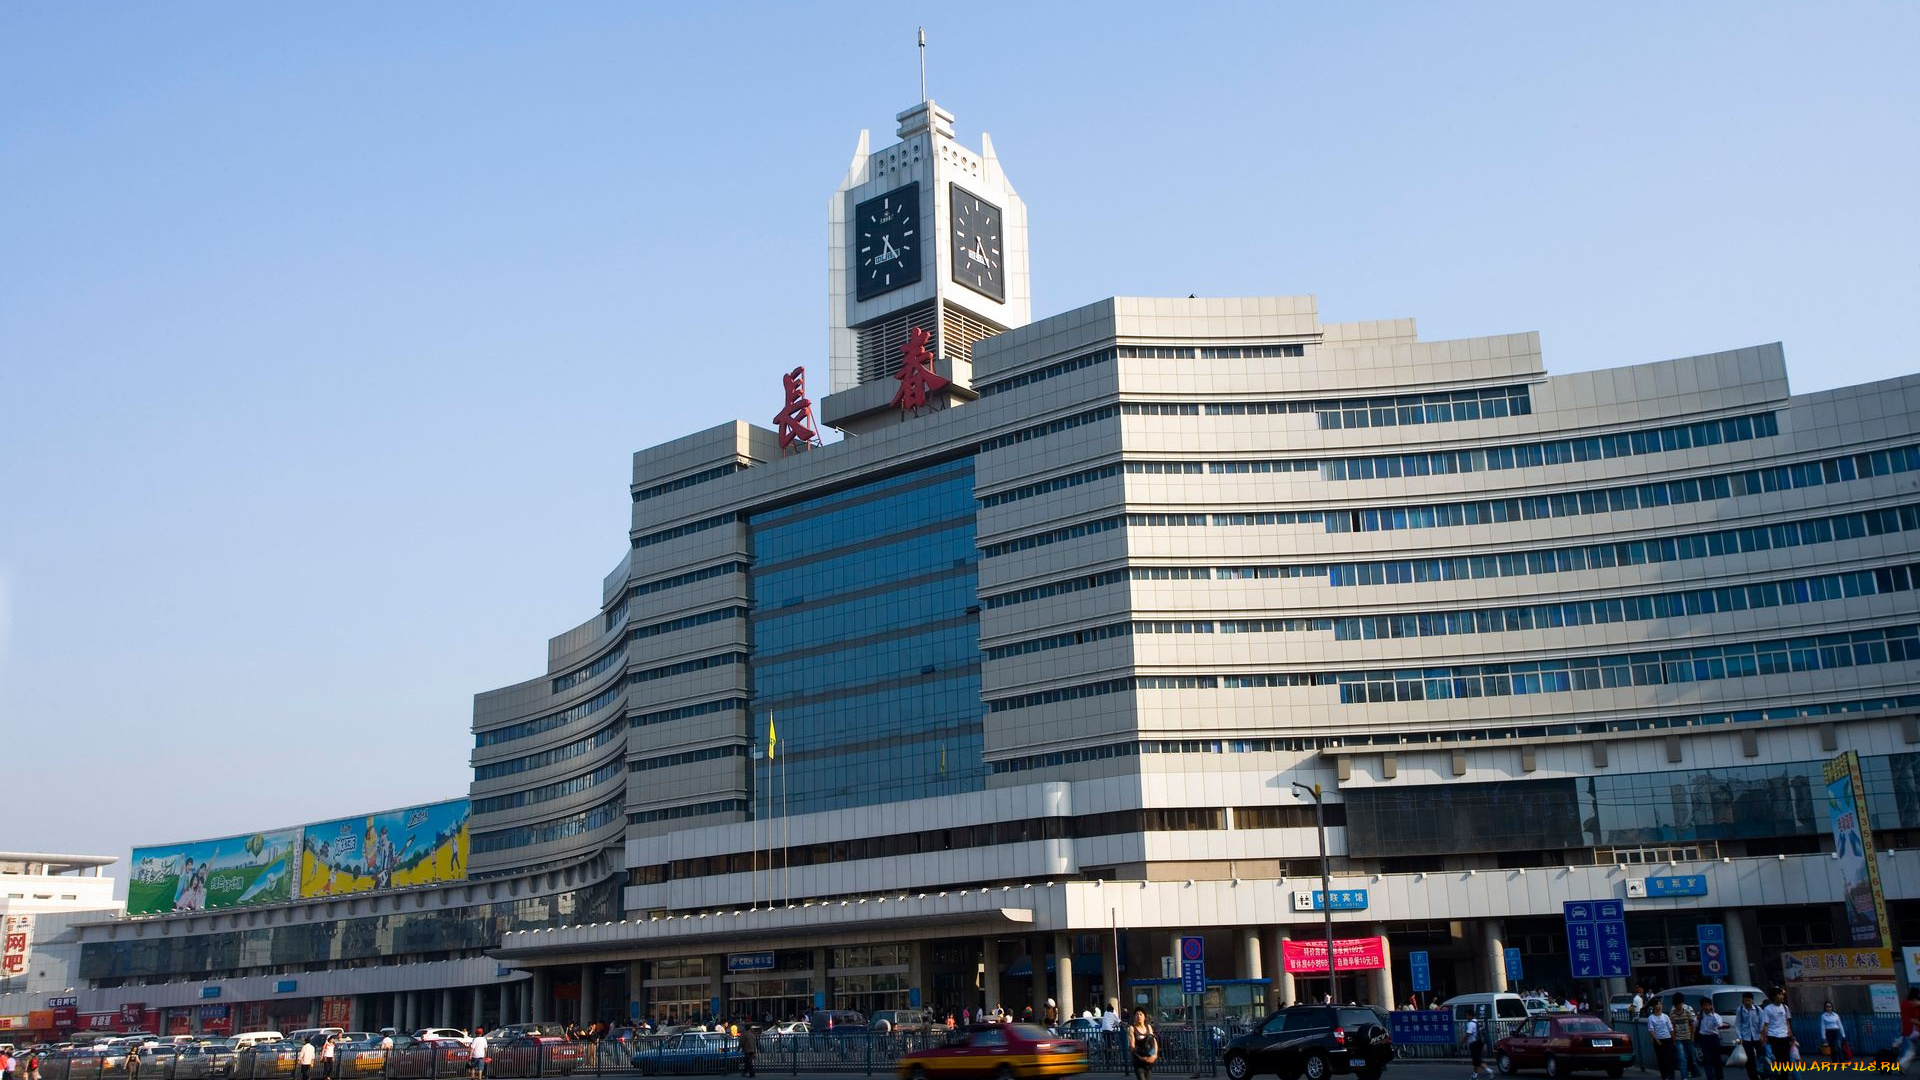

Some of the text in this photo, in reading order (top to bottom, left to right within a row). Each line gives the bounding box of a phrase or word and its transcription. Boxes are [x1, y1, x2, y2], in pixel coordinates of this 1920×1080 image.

[3, 933, 27, 973] 网吧
[739, 957, 754, 965] CRH
[1576, 926, 1591, 962] 出租车
[1604, 925, 1621, 962] 社会车
[1395, 1024, 1449, 1032] 禁止停车下客
